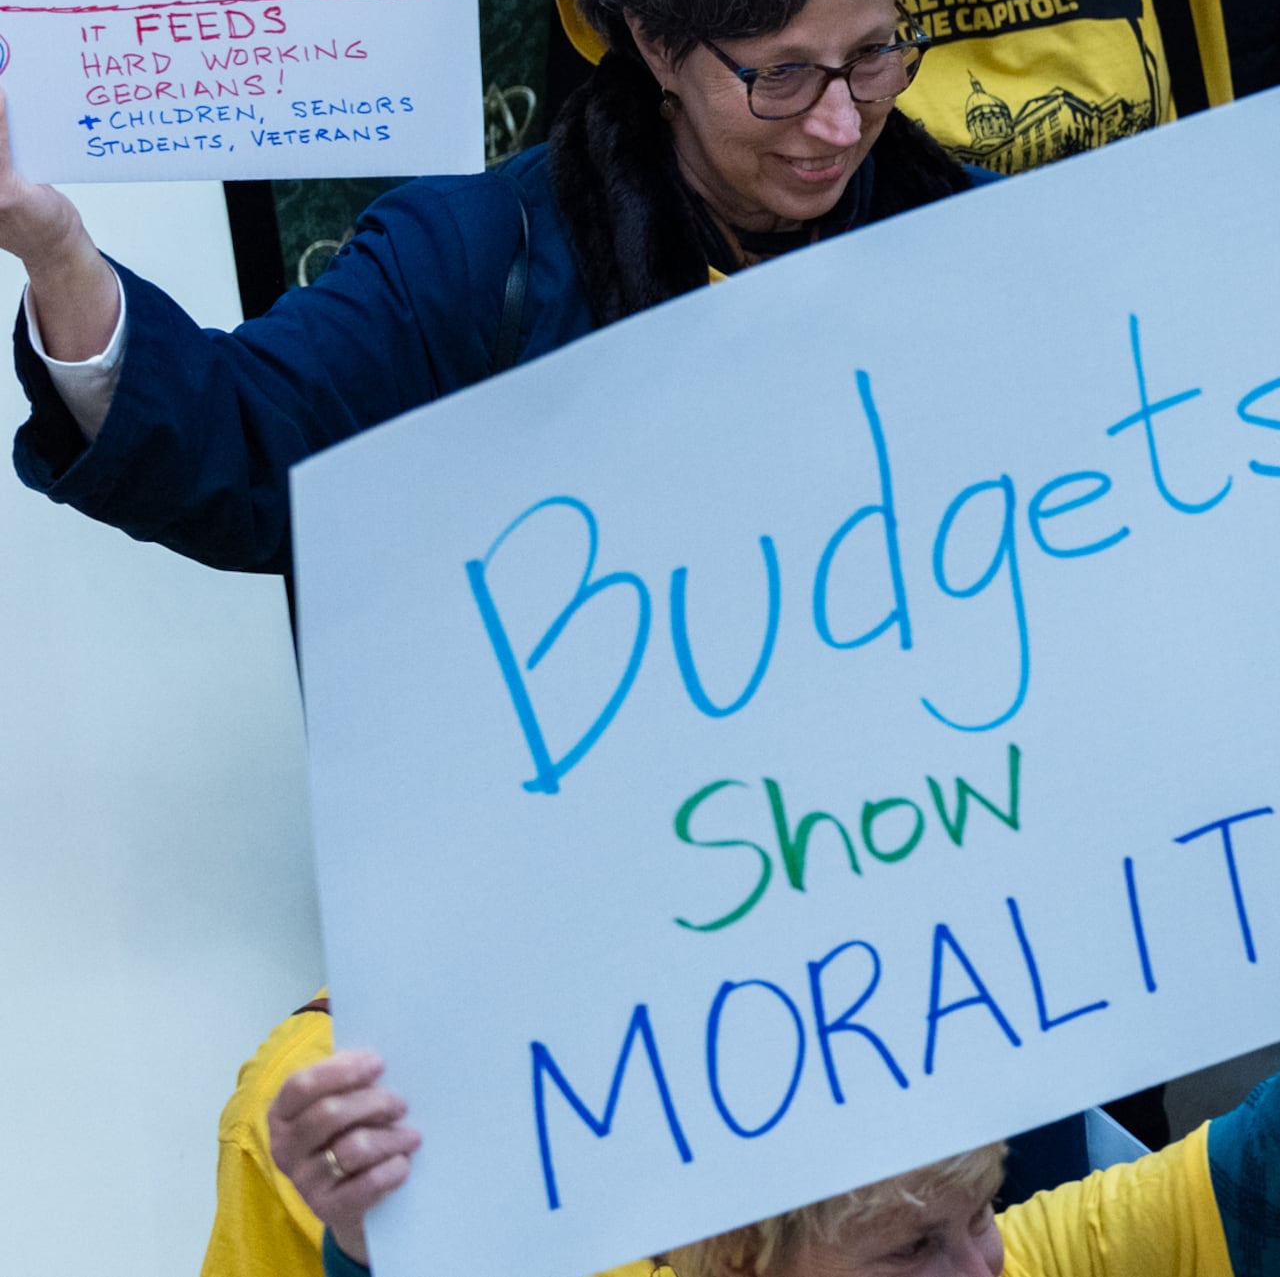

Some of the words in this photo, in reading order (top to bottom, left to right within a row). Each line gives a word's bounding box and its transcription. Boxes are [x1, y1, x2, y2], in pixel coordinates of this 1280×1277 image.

[81, 26, 106, 43] IT
[135, 7, 286, 45] FEEDS
[81, 52, 171, 78] HARD
[204, 39, 368, 71] WORKING
[85, 69, 285, 106] GEORIANS!
[109, 105, 265, 130] CHILDREN,
[291, 97, 414, 118] SENIORS
[86, 135, 235, 157] STUDENTS,
[251, 126, 391, 148] VETERANS
[673, 742, 1023, 933] Show
